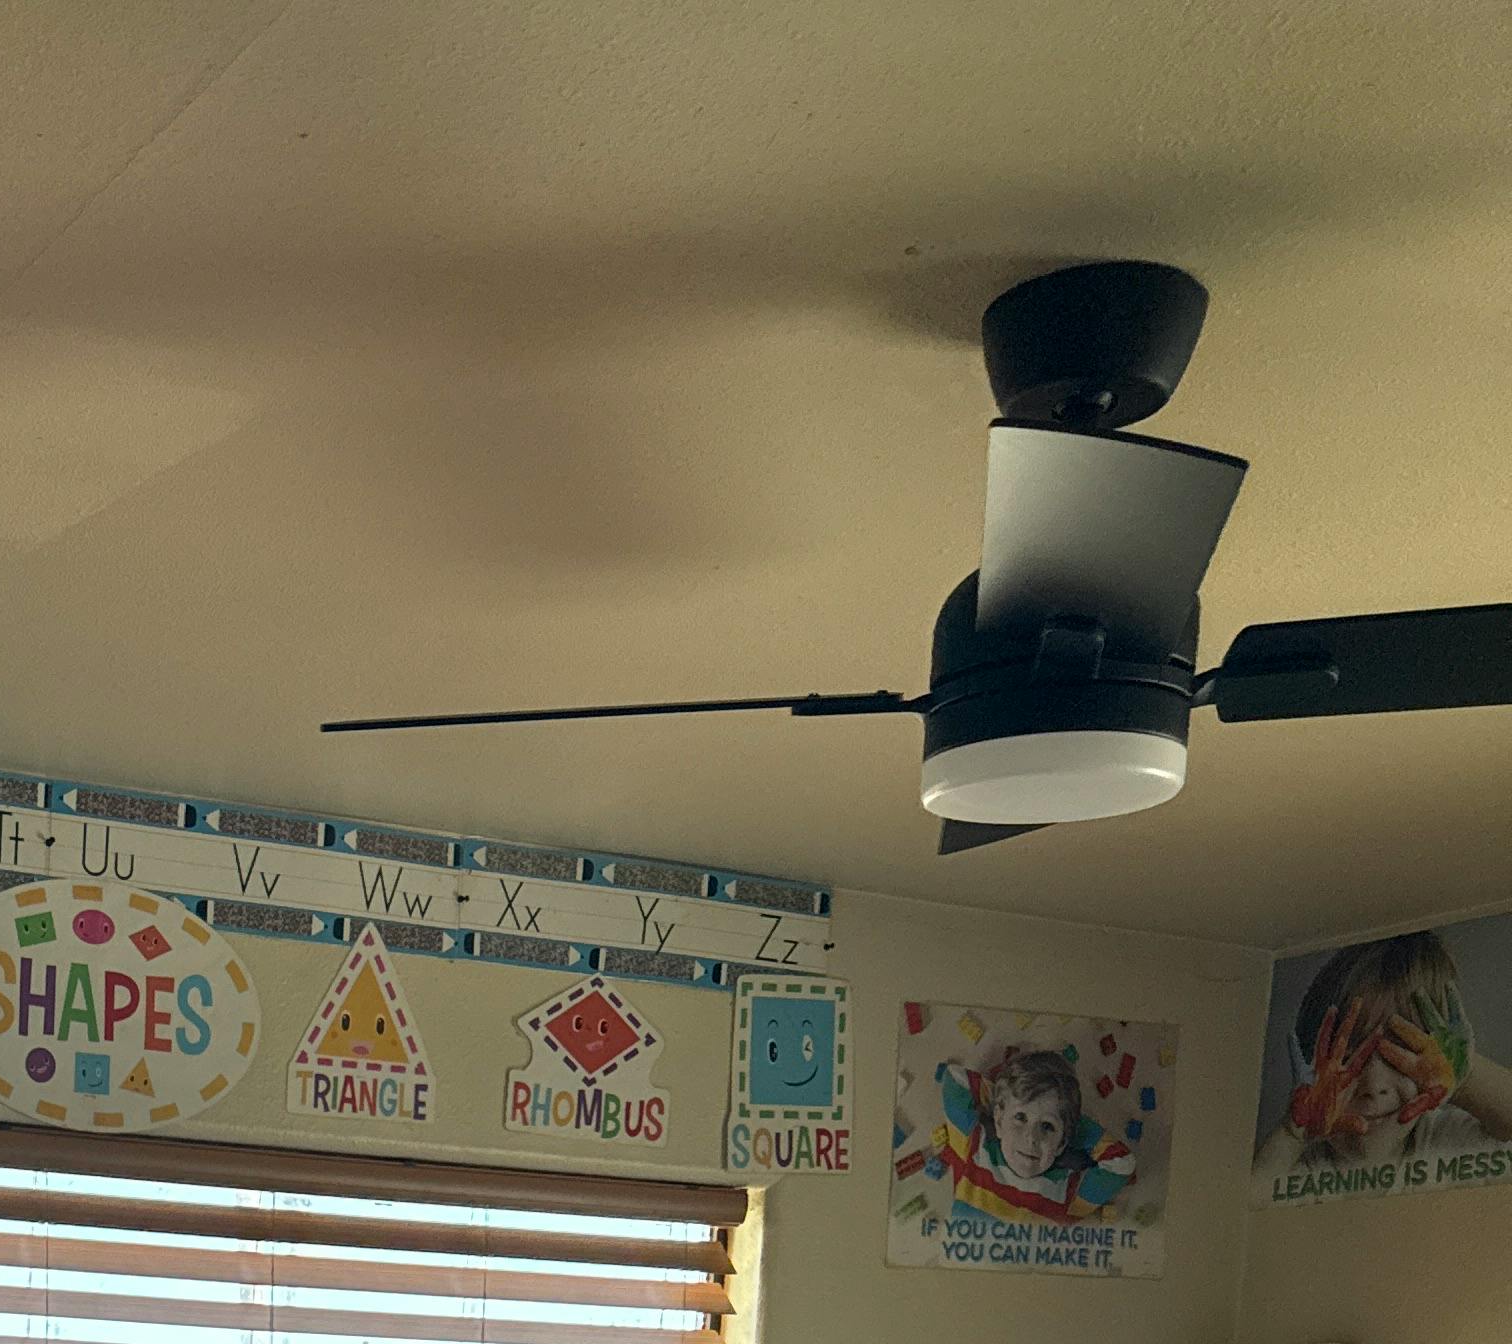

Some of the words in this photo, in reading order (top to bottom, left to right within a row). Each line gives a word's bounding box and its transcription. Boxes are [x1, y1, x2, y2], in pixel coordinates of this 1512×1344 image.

[81, 822, 135, 880] Uu
[232, 842, 281, 898] Vv
[358, 861, 433, 918] Ww
[496, 879, 541, 932] Xx
[635, 896, 675, 954] Yy
[755, 913, 799, 965] Zz
[296, 1071, 428, 1120] TRIANGLE
[511, 1082, 665, 1141] RHOMBUS
[730, 1124, 850, 1171] SQUARE
[1272, 1164, 1396, 1201] LEARNING
[1404, 1159, 1428, 1186] IS
[921, 1217, 938, 1237] IF
[944, 1218, 987, 1239] YOU
[991, 1221, 1032, 1241] CAN
[1038, 1223, 1116, 1247] IMAGINE
[942, 1241, 984, 1262] YOU
[990, 1243, 1029, 1264] CAN
[1035, 1246, 1089, 1268] MAKE
